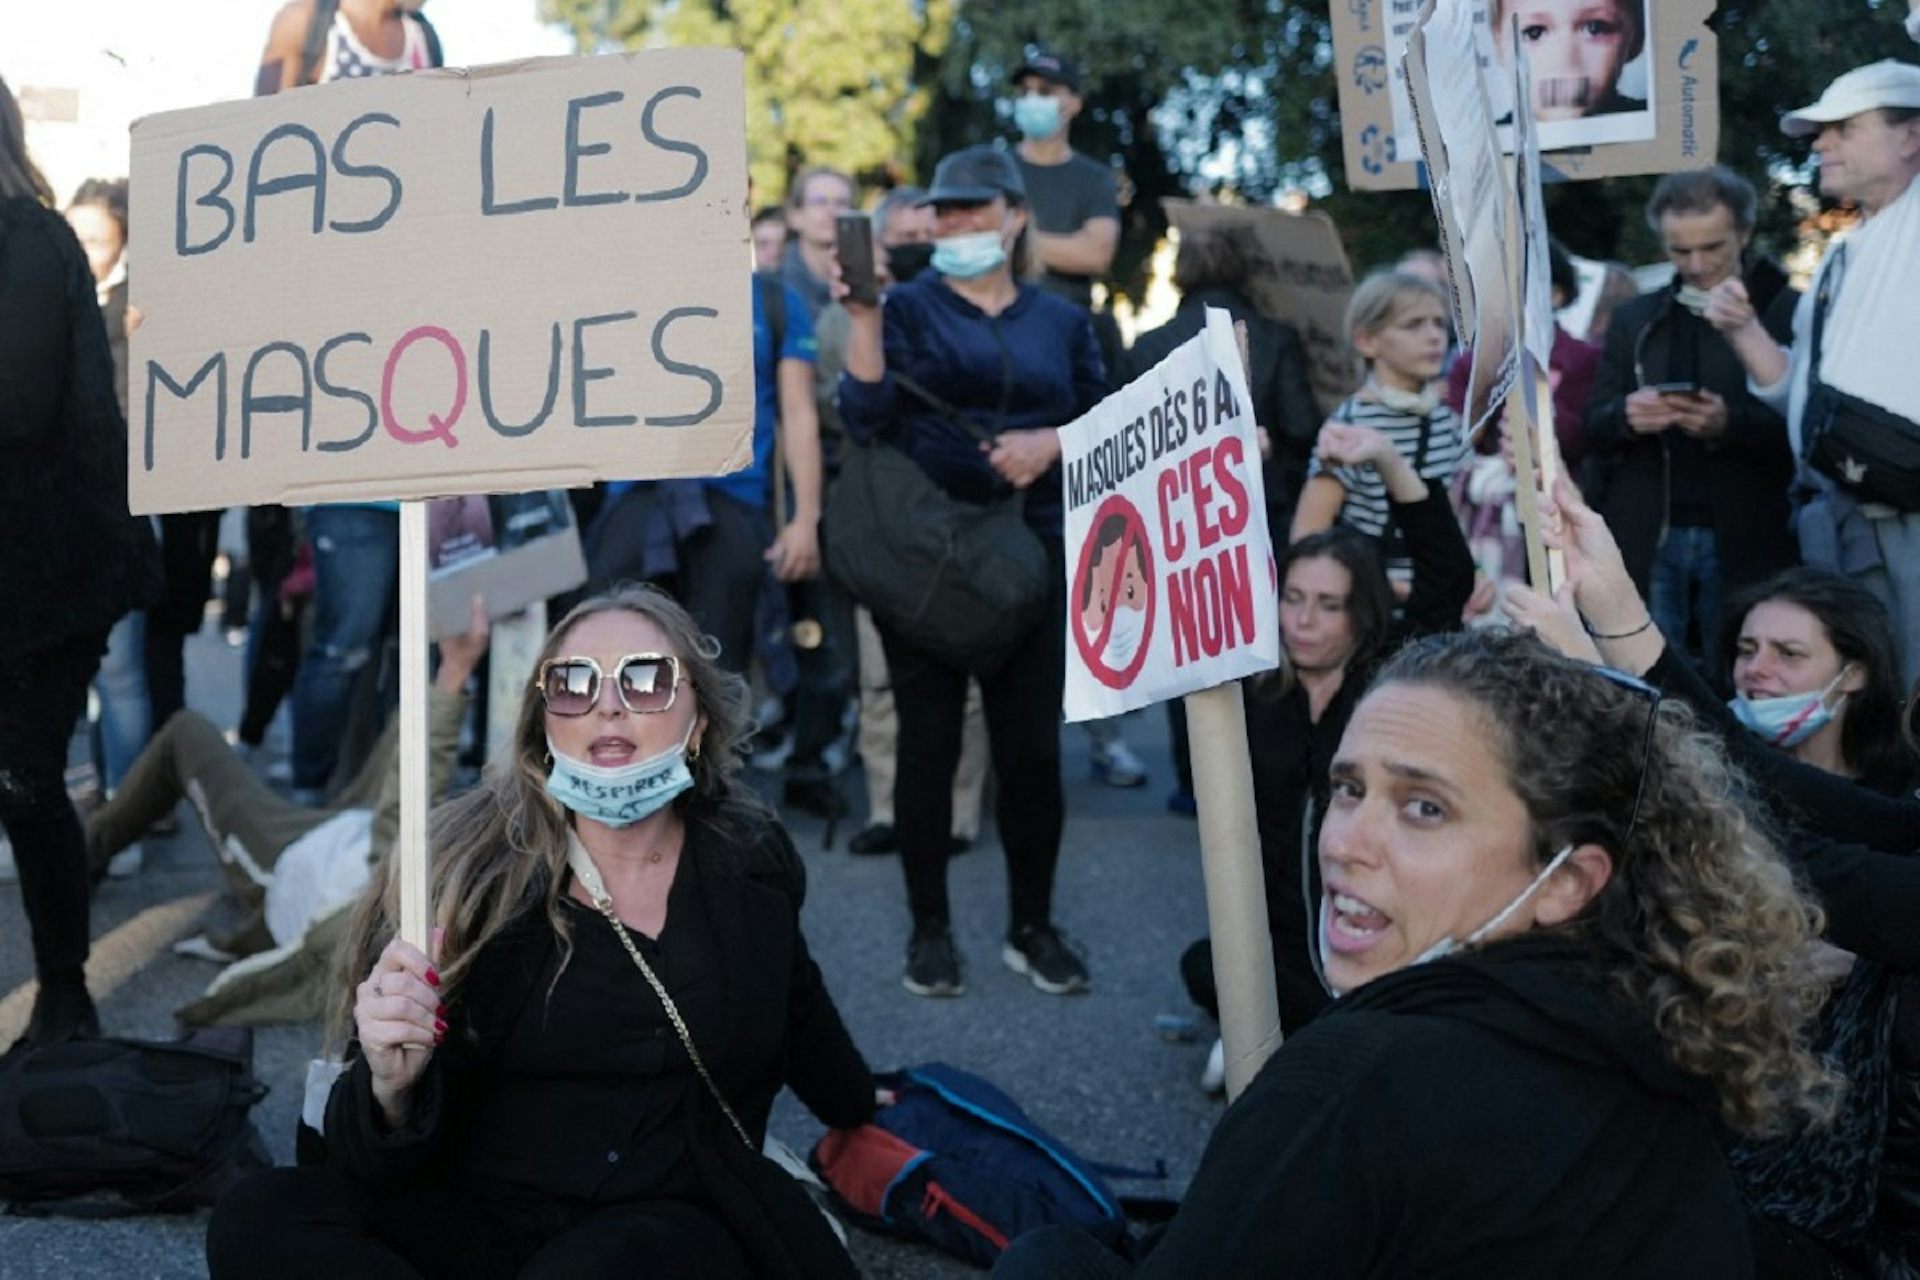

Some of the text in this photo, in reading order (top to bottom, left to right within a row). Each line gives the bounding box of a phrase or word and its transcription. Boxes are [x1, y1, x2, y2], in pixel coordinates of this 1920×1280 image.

[176, 86, 709, 256] BAS LES
[1681, 75, 1698, 158] Automatic
[144, 306, 723, 471] MASQUES
[1068, 416, 1146, 512] MASQUES
[1148, 387, 1188, 461] DÈS
[1192, 376, 1207, 436] 6
[1167, 544, 1256, 667] NON
[570, 767, 677, 799] RESPIRER
